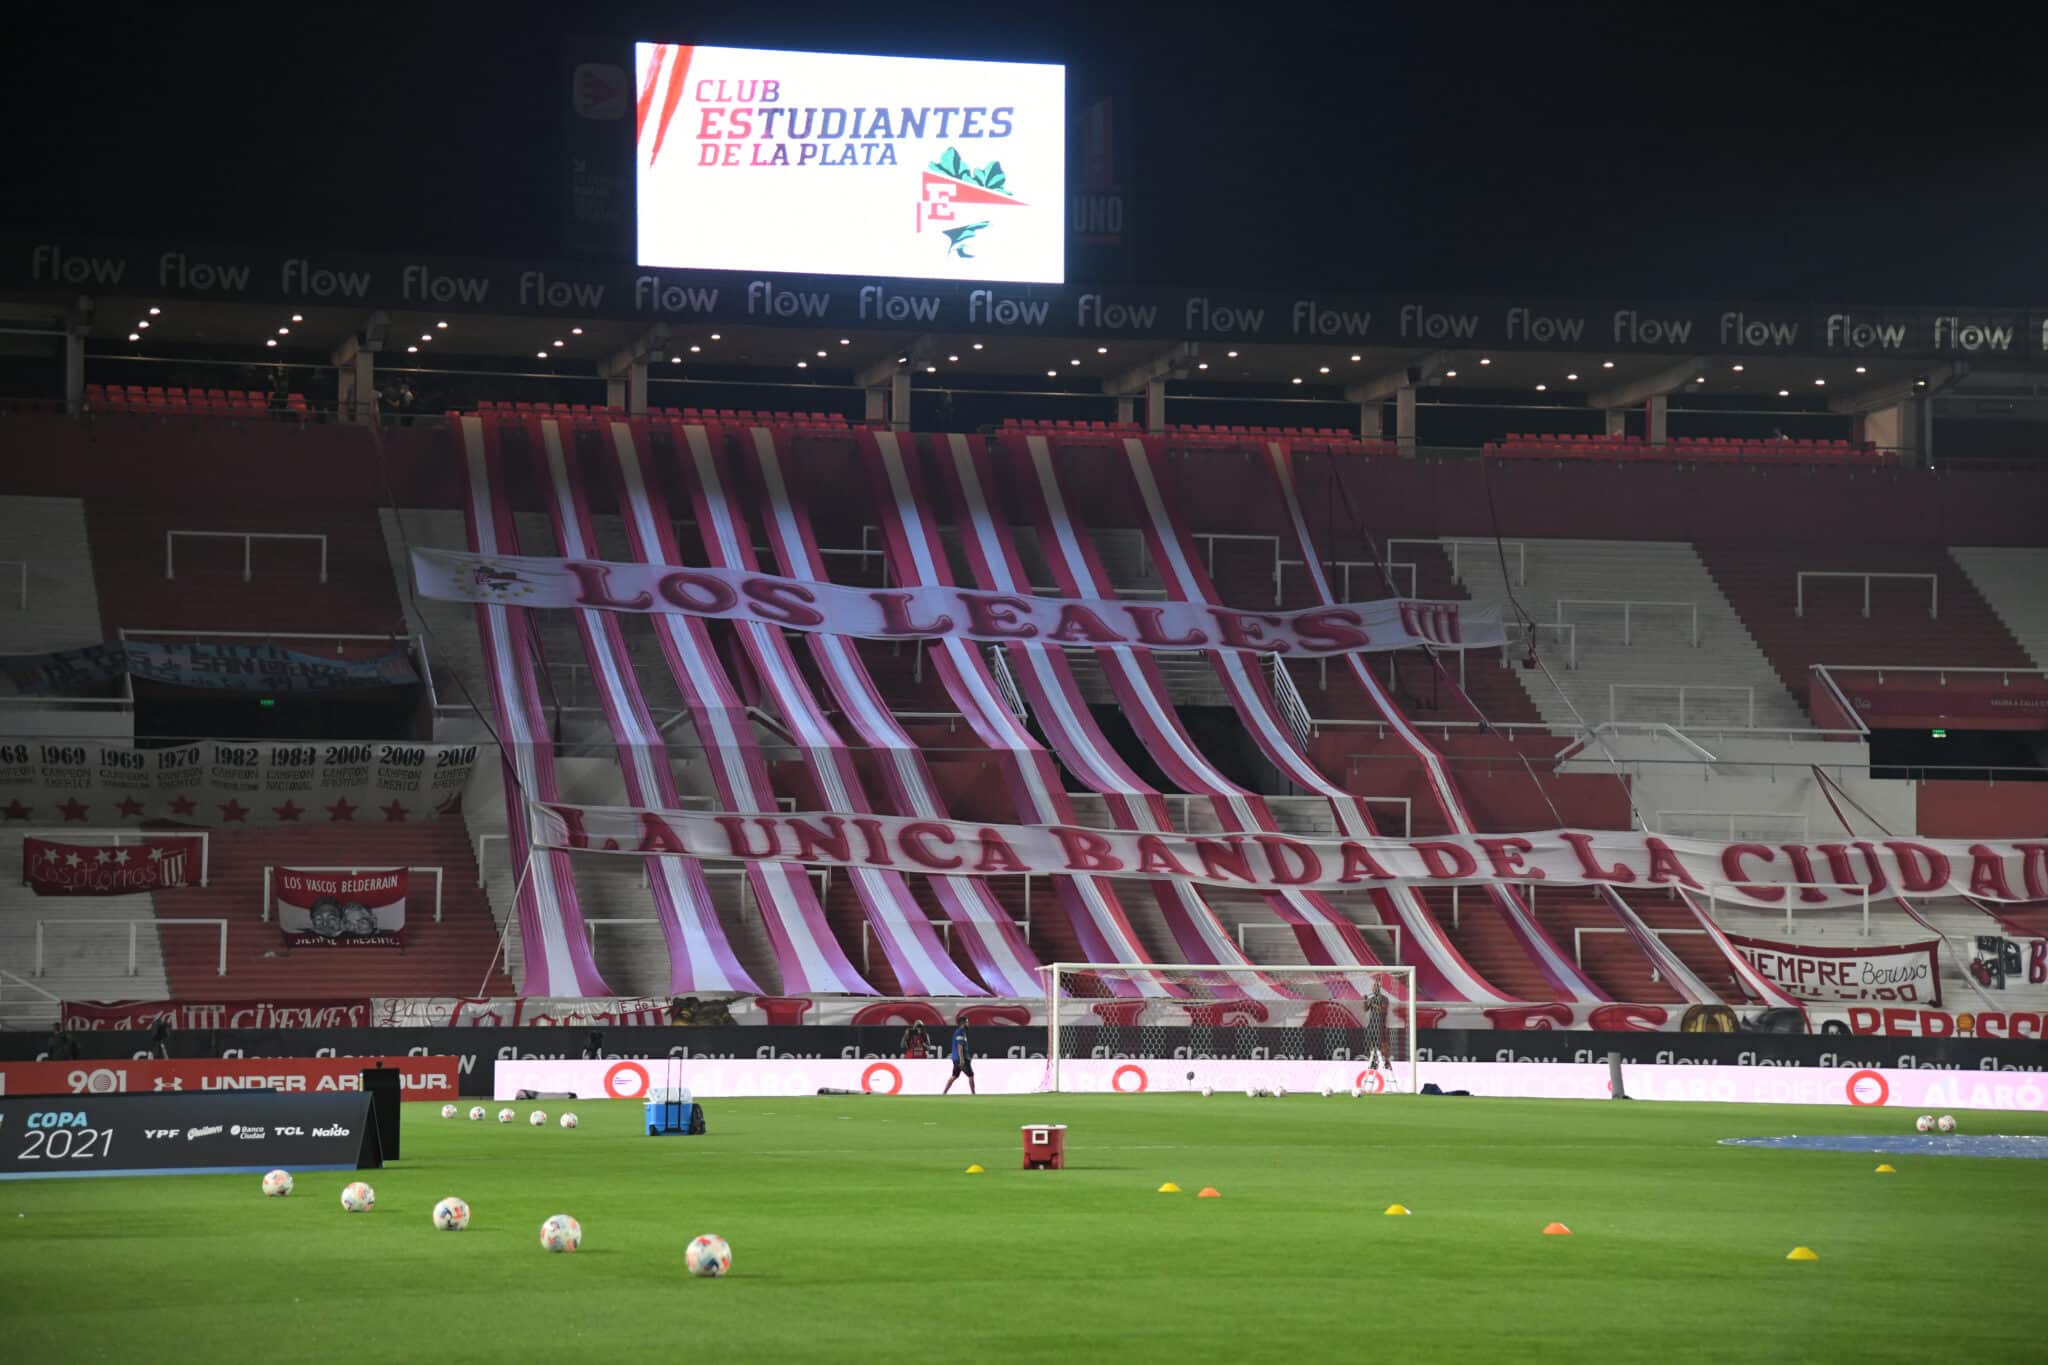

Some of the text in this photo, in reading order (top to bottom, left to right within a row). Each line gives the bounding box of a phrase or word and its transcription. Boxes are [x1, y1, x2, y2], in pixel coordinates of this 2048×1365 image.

[695, 79, 781, 103] CLUB
[695, 106, 1015, 140] ESTUDIANTES
[698, 143, 898, 167] DE LA PLATA
[1072, 194, 1123, 233] UNO
[31, 244, 127, 285] flow
[159, 252, 251, 293] flow
[281, 259, 372, 298] flow
[402, 265, 489, 303] flow
[520, 271, 606, 308] flow
[634, 275, 719, 314] flow
[747, 281, 831, 318] flow
[858, 285, 941, 322] flow
[969, 290, 1049, 326] flow
[1077, 293, 1158, 329] flow
[1185, 297, 1265, 332] flow
[1292, 301, 1372, 336] flow
[1400, 304, 1479, 340] flow
[1506, 307, 1585, 342] flow
[1613, 310, 1693, 345] flow
[1720, 311, 1799, 347] flow
[1826, 314, 1906, 349] flow
[1933, 316, 2015, 351] flow
[563, 563, 1372, 654] LOS LEALES
[40, 745, 87, 766] 1969
[100, 748, 145, 770] 1969
[158, 747, 200, 770] 1970
[214, 746, 259, 767] 1982
[271, 746, 317, 767] 1983
[325, 744, 372, 766] 2006
[379, 745, 425, 767] 2009
[436, 746, 477, 768] 2010
[549, 806, 690, 853] LA
[714, 814, 1032, 872] UNICA
[1049, 827, 1396, 885] BANDA
[1409, 837, 1546, 880] DE
[1560, 832, 1705, 890] LA
[284, 875, 399, 893] LOS VASCOS BELDERRAIN
[66, 1068, 127, 1094] 901
[201, 1074, 448, 1092] UNDER ARUR
[1752, 1078, 1902, 1104] EDIFICS
[1923, 1075, 2043, 1108] ALARÓ
[27, 1111, 88, 1128] COPA
[274, 1126, 305, 1136] TCL
[311, 1125, 350, 1138] Naldo
[17, 1127, 114, 1159] 2021
[144, 1129, 181, 1139] YPF
